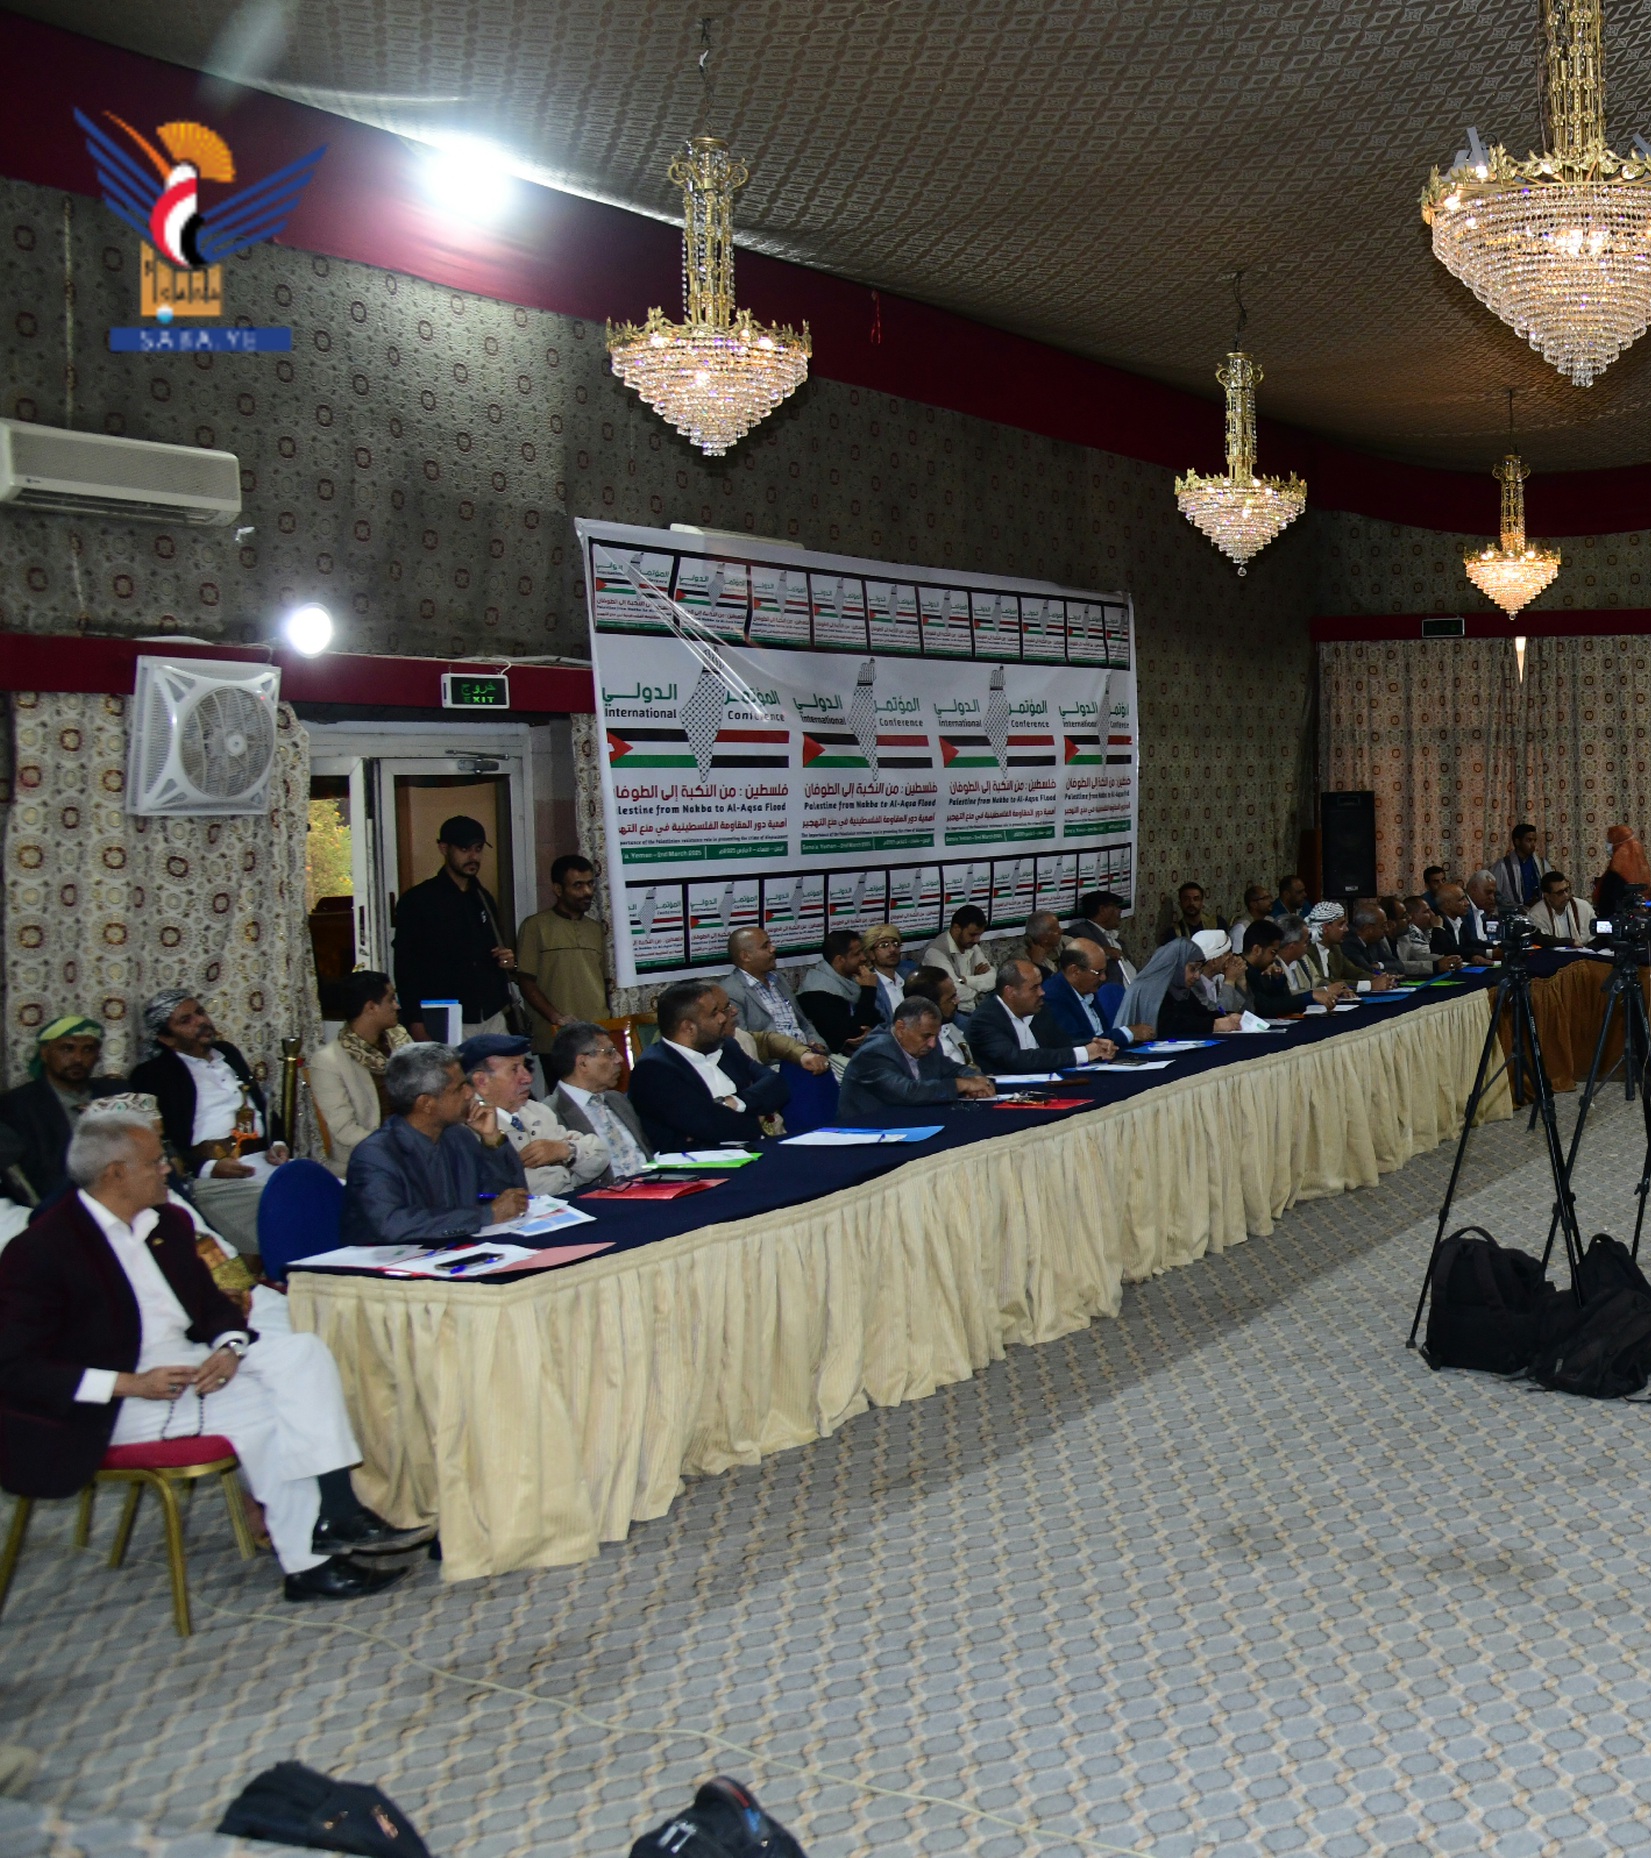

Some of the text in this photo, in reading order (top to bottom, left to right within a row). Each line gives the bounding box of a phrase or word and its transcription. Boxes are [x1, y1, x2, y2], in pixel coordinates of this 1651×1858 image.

[461, 681, 497, 696] خروج
[602, 682, 677, 707] الدولي
[793, 693, 921, 714] المؤتمر الدولي
[605, 707, 677, 719] International
[801, 715, 923, 727] International Conference
[661, 785, 678, 802] إلى
[681, 784, 716, 800] النكبة
[720, 784, 736, 799] من
[745, 784, 788, 799] فلسطين
[656, 805, 680, 816] from
[683, 804, 712, 813] Nakba
[715, 804, 724, 812] to
[727, 803, 762, 813] Al-Aqsa
[765, 802, 786, 811] Flood
